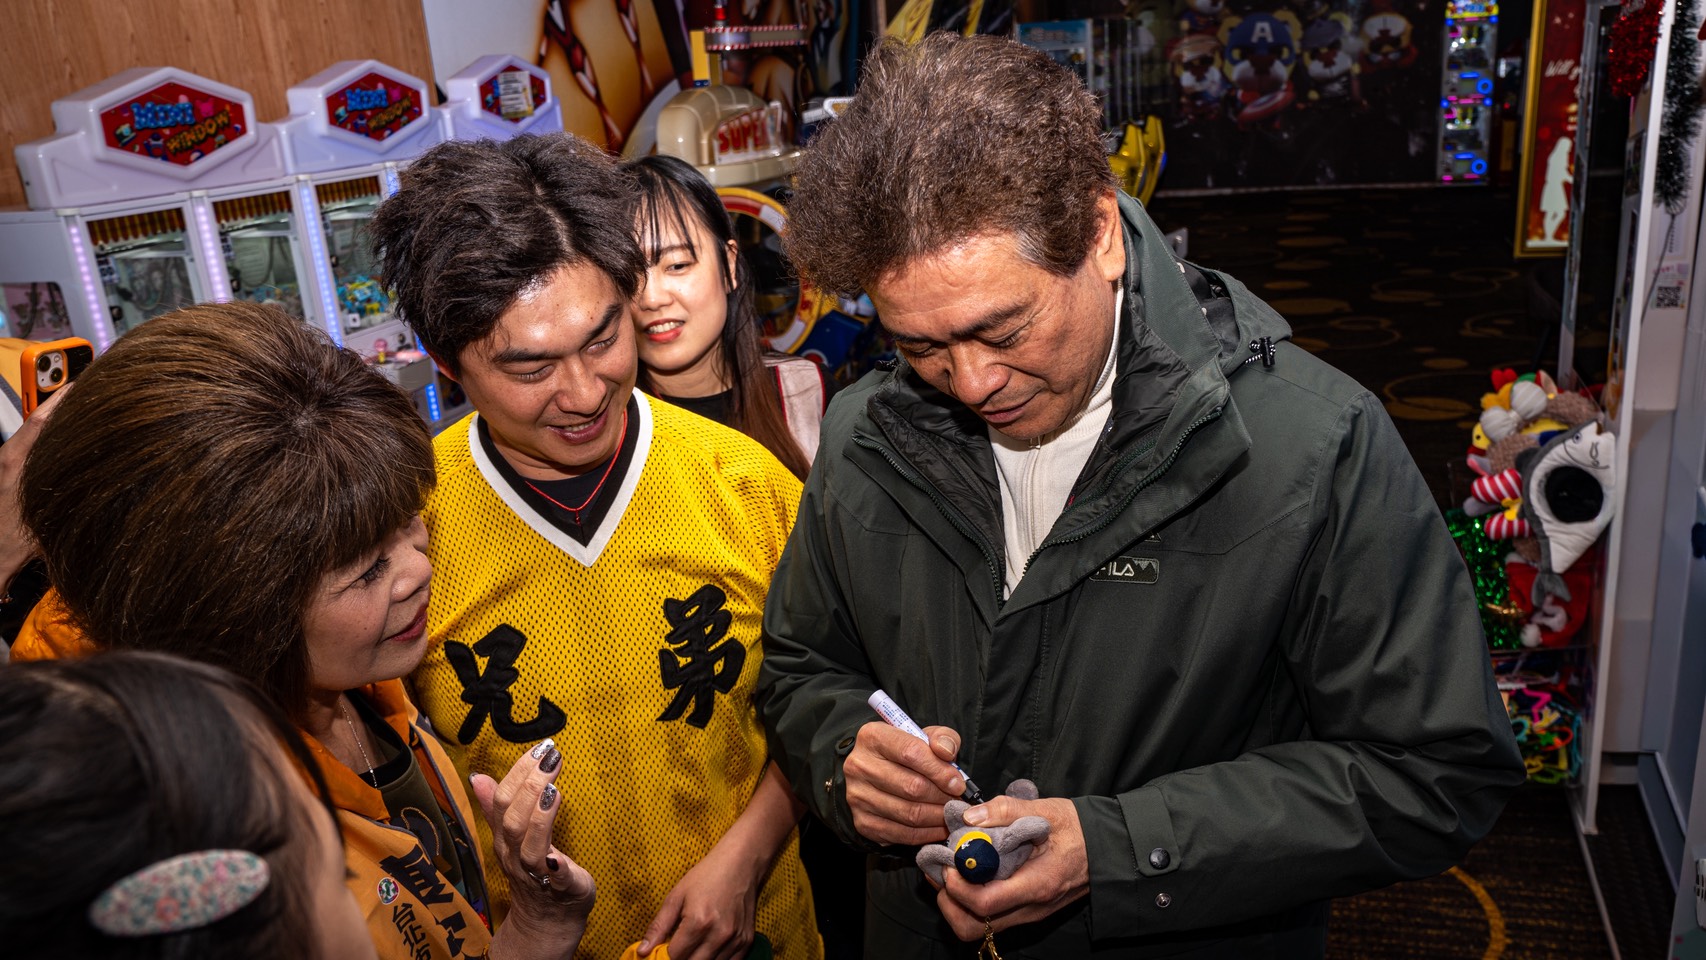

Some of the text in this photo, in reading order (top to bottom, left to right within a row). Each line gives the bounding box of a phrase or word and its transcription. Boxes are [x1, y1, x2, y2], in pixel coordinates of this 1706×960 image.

[164, 110, 230, 154] WINDOW
[443, 583, 746, 745] 兄 弟
